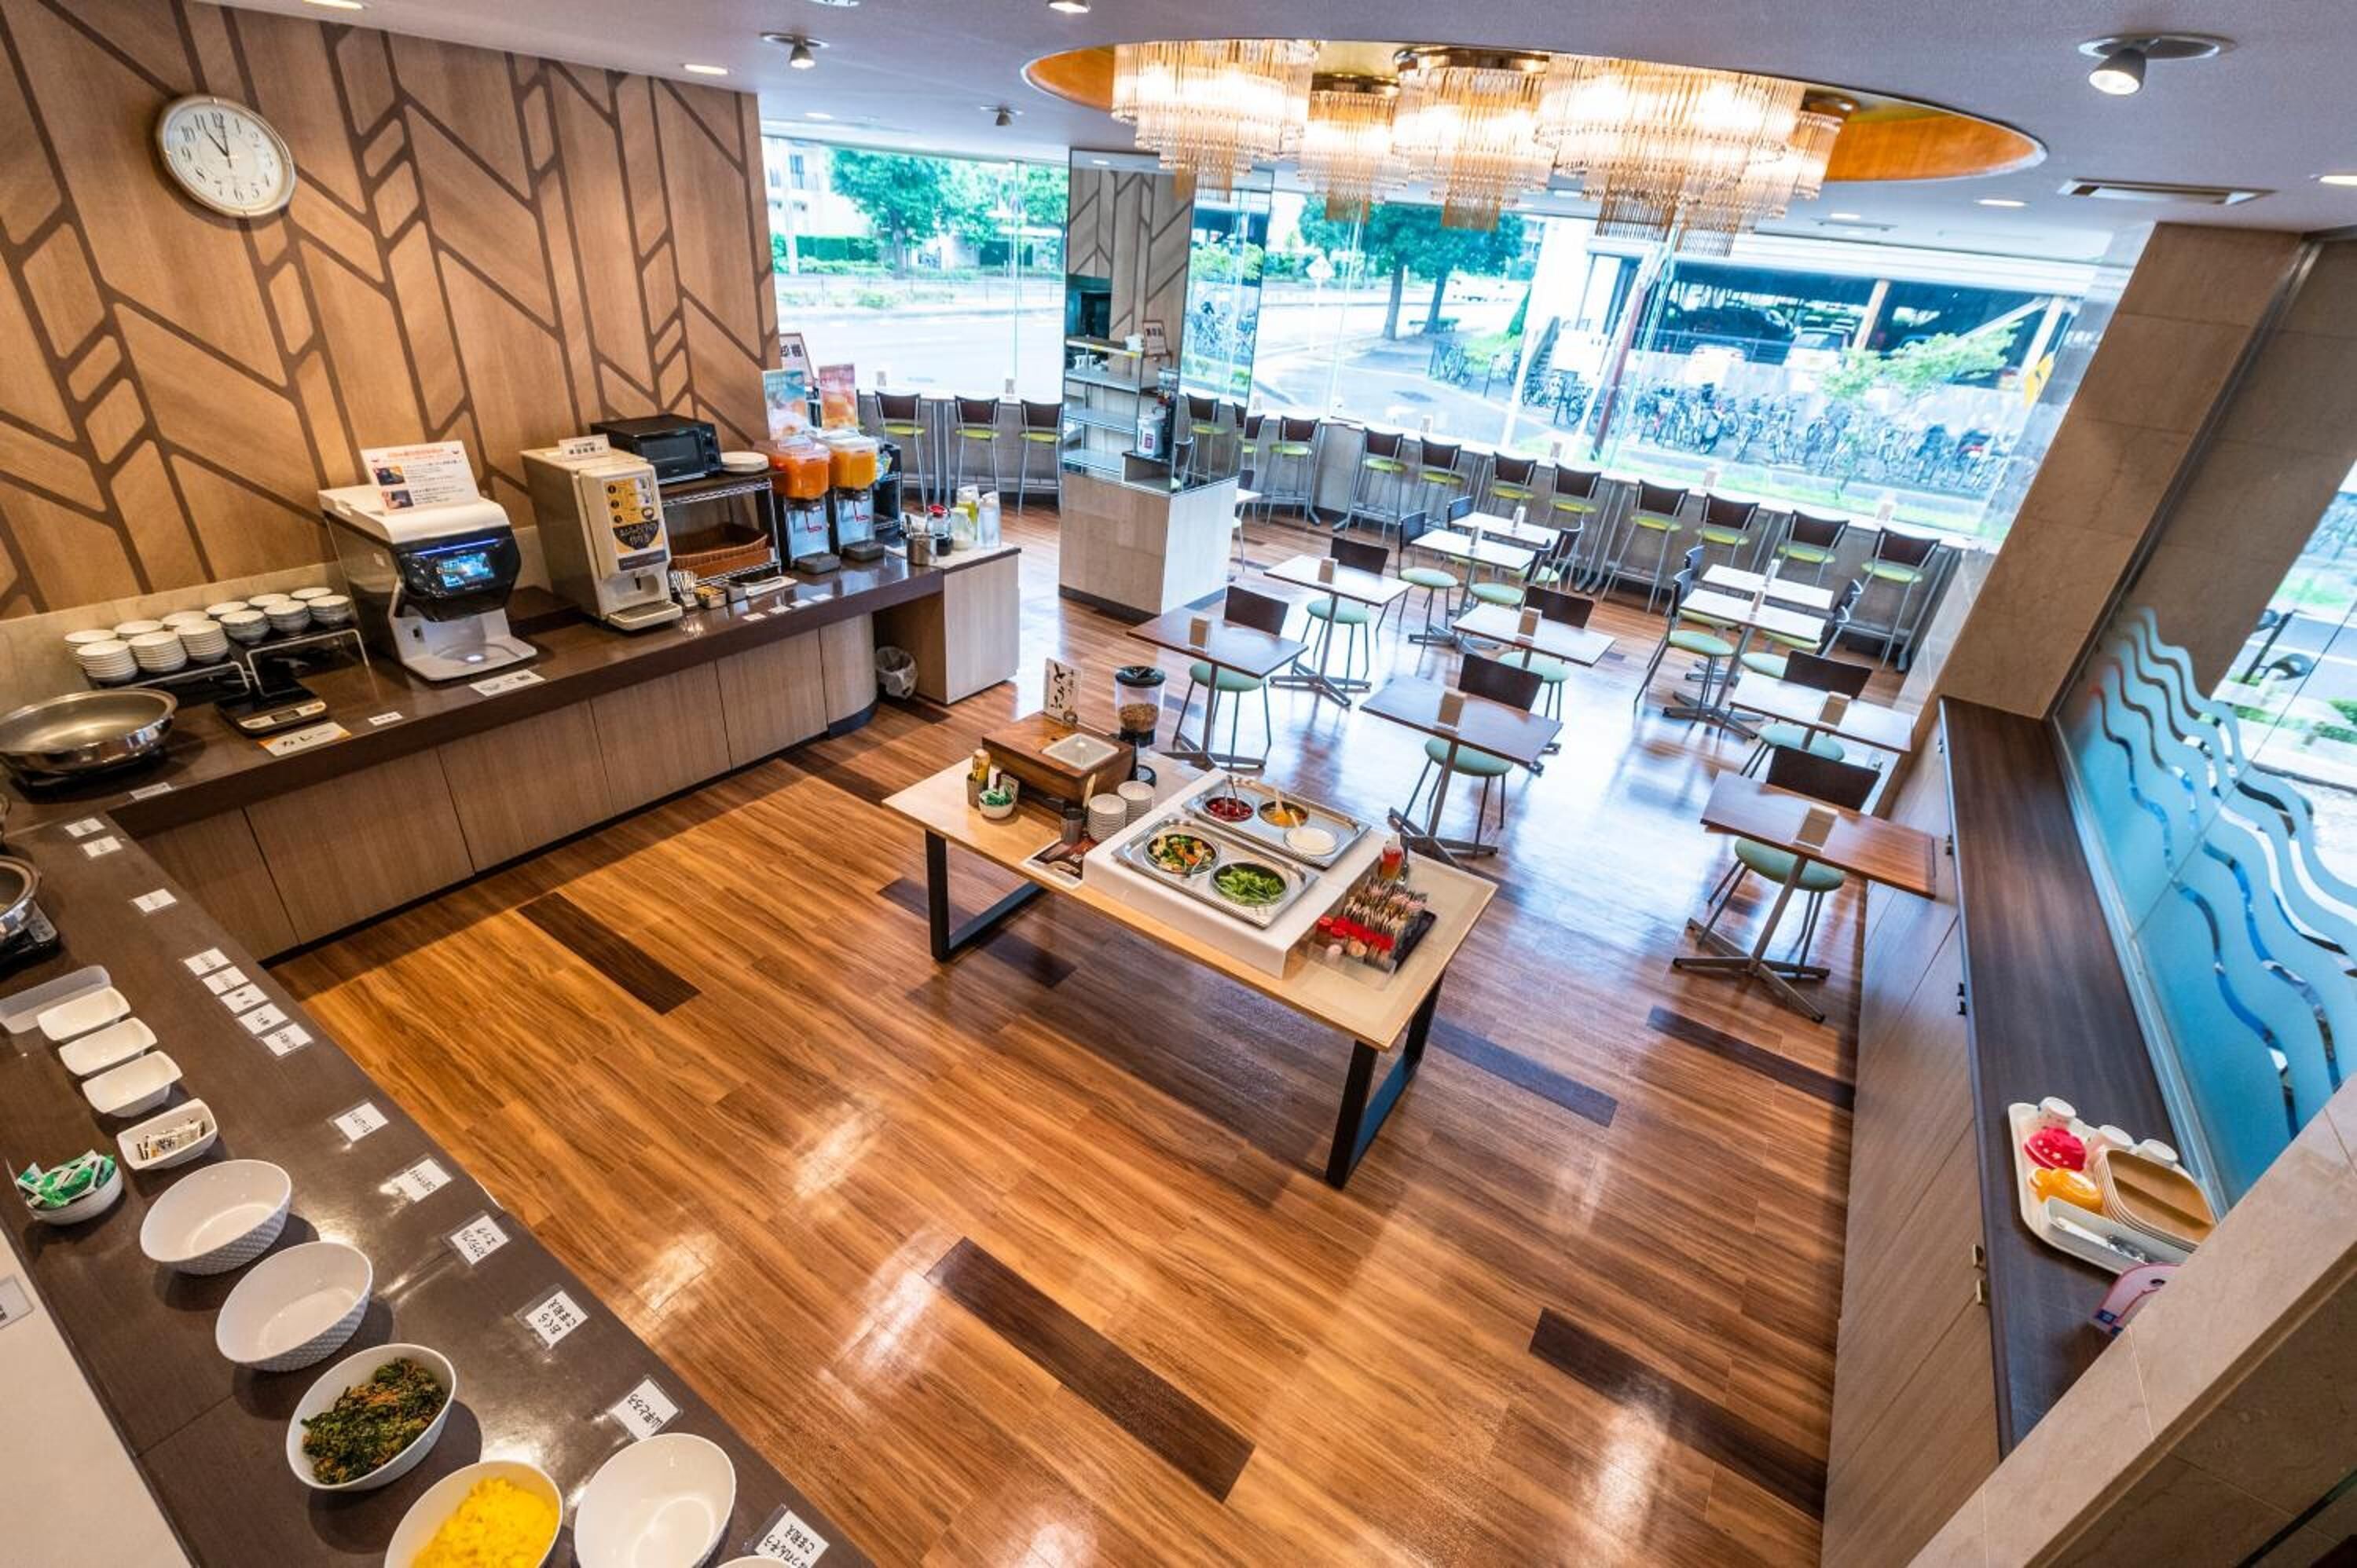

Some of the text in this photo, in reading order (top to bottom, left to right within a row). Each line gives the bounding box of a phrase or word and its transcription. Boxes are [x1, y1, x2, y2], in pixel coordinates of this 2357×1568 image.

[194, 114, 207, 130] 11
[235, 118, 242, 135] 1
[180, 125, 196, 142] 10
[251, 131, 260, 148] 2
[181, 148, 192, 163] 9
[214, 180, 224, 197] 7
[233, 186, 244, 202] 6
[251, 182, 260, 199] 5
[537, 1313, 563, 1335] おくら
[627, 1393, 664, 1428] 山芋とろろ
